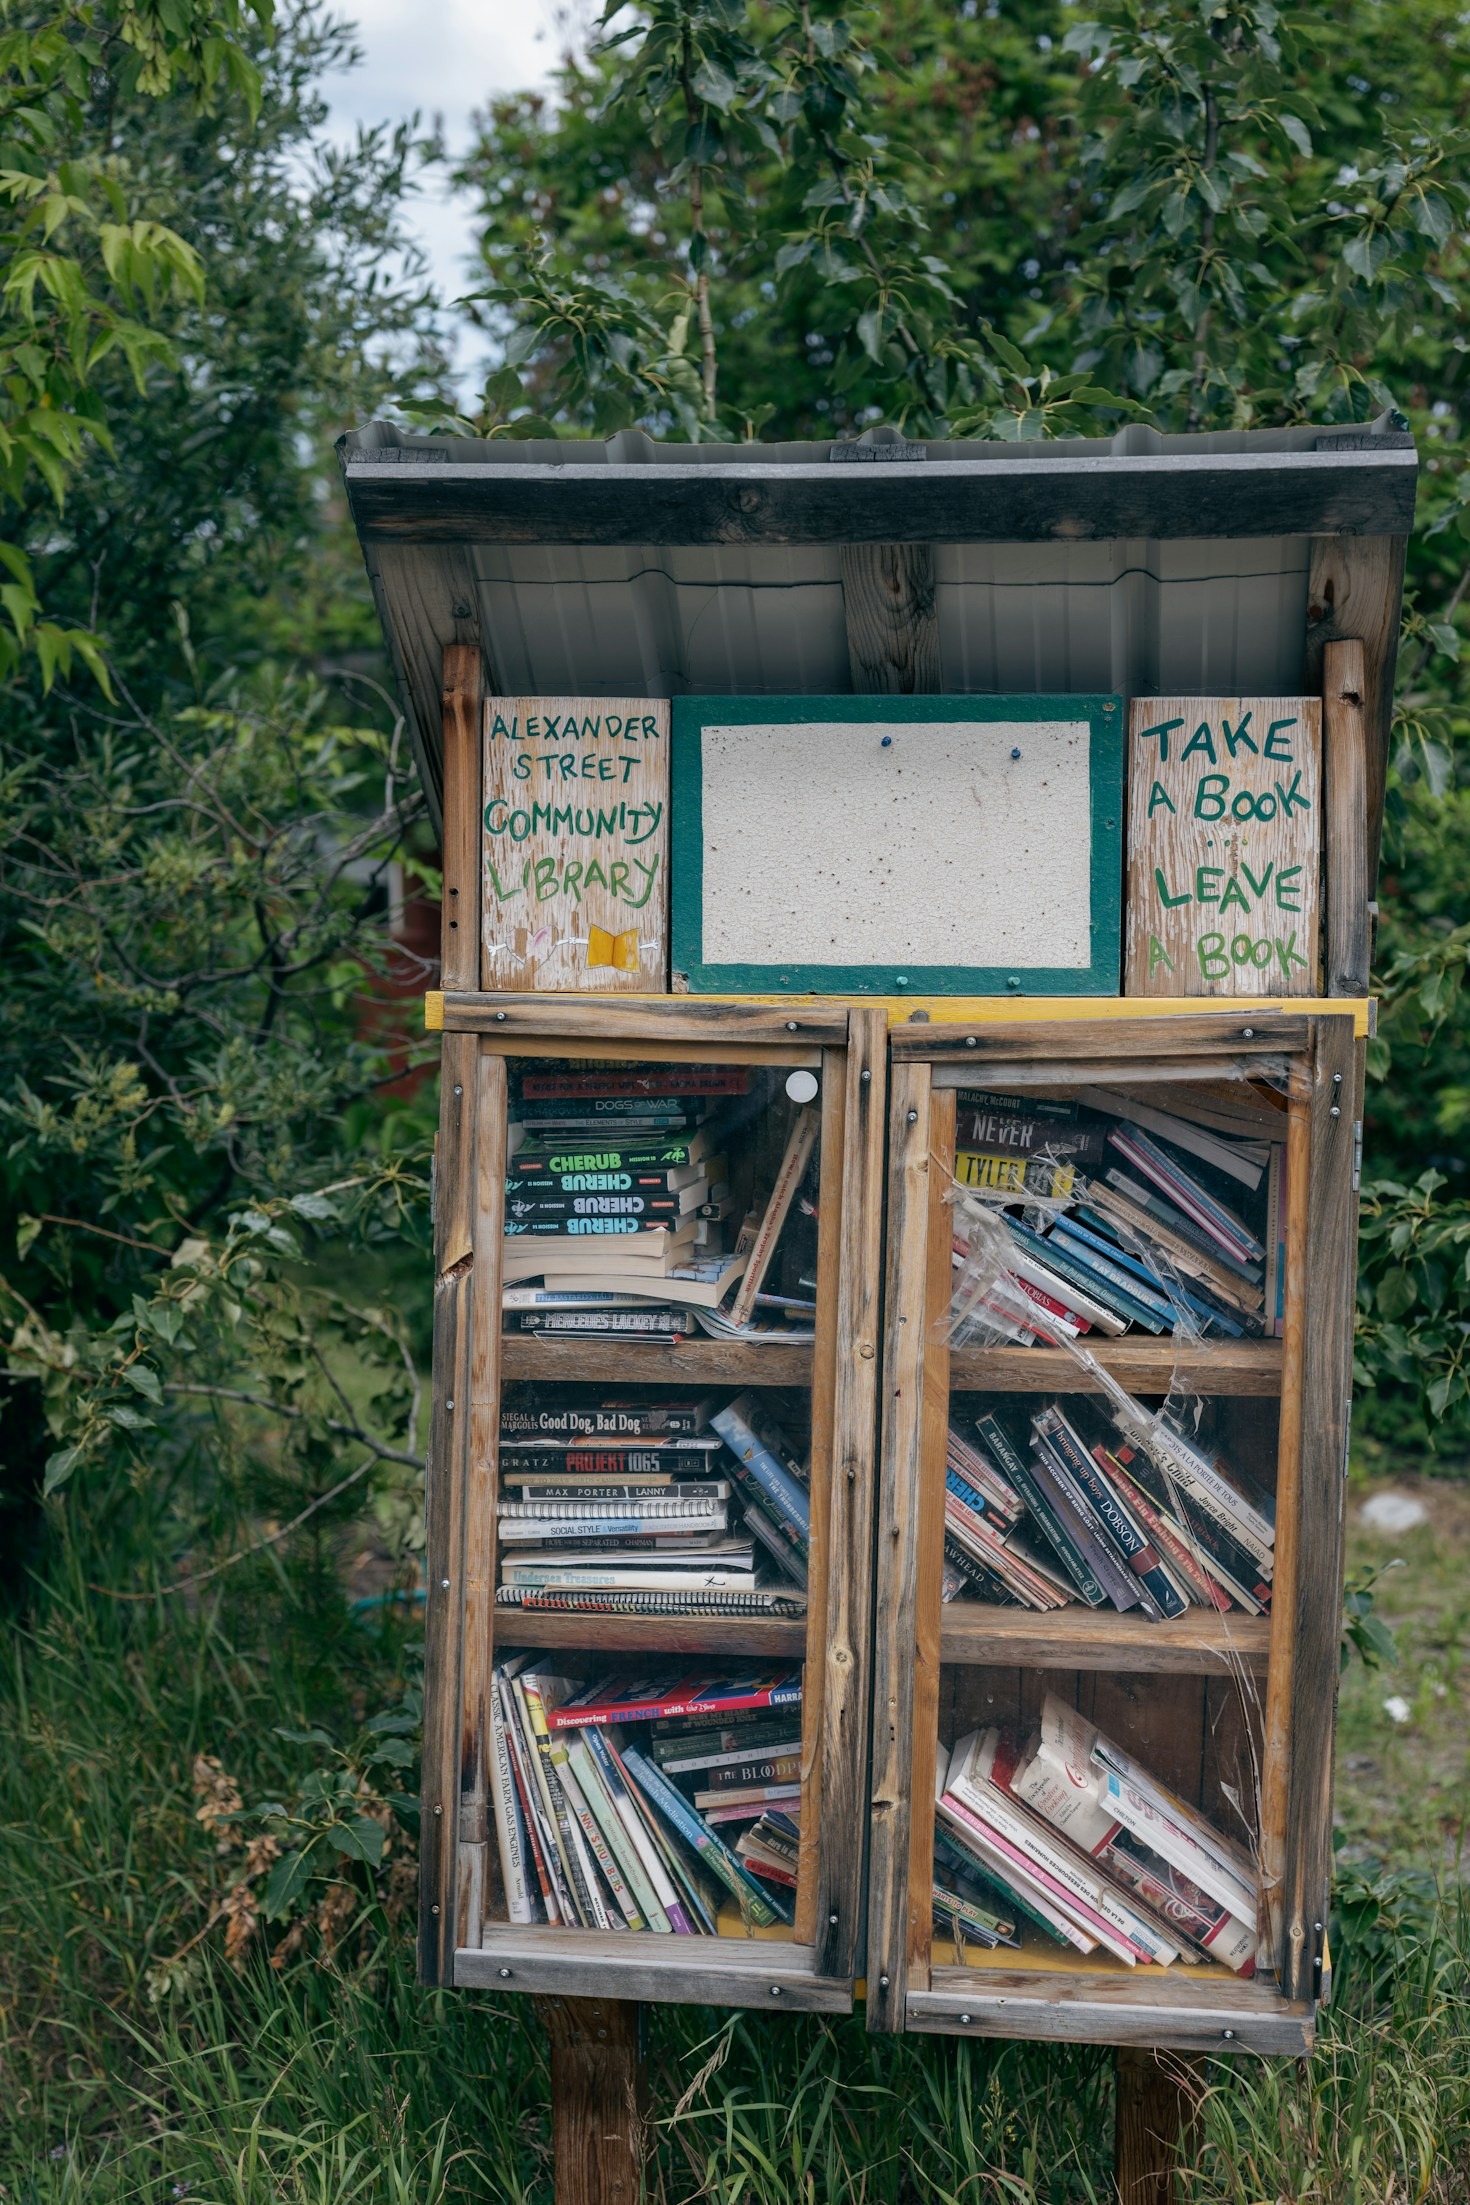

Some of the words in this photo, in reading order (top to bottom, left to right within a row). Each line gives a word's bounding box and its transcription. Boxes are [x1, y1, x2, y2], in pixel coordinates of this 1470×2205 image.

[491, 714, 659, 741] ALEXANDER
[1141, 711, 1298, 765] TAKE
[513, 753, 641, 783] STREET
[1148, 781, 1176, 818] A
[1194, 769, 1311, 822] BOOK
[484, 799, 663, 845] COMMUNITY
[487, 853, 660, 909] LIBRARY
[1155, 861, 1302, 915] LEAVE
[1150, 934, 1175, 979] A
[1198, 930, 1308, 980] BOOK
[595, 1100, 632, 1110] DOGS
[645, 1098, 677, 1109] WAR
[957, 1090, 988, 1105] MALACHY
[989, 1095, 1020, 1107] McCOURT
[972, 1114, 1034, 1148] NEVER
[548, 1152, 622, 1173] CHERUB
[787, 1152, 799, 1169] How
[560, 1172, 631, 1192] CHERUB
[784, 1171, 791, 1179] to
[963, 1156, 1018, 1190] TYLER
[777, 1179, 789, 1200] catch
[572, 1194, 644, 1215] CHERUB
[766, 1200, 783, 1231] Alaska's
[565, 1216, 638, 1234] CHERUB
[754, 1231, 771, 1258] Trophy
[741, 1258, 761, 1293] Sportfish
[1058, 1261, 1069, 1271] THE
[1086, 1279, 1103, 1293] SOCIAL
[1091, 1260, 1110, 1276] RAY
[1108, 1272, 1155, 1306] BRADBURY
[1021, 1283, 1052, 1306] TOBIAS
[544, 1313, 608, 1328] MERCEDES
[612, 1314, 656, 1330] LACKEY
[501, 1413, 528, 1421] SIEGAL
[501, 1421, 538, 1430] MARGOLIS
[539, 1412, 567, 1429] Good
[569, 1414, 594, 1434] Dog,
[596, 1414, 616, 1430] Bad
[618, 1415, 640, 1434] Dog
[502, 1458, 550, 1466] GRATZ
[566, 1452, 625, 1471] PROJEKT
[628, 1452, 660, 1471] 1065
[987, 1431, 1019, 1473] BARANGAY
[1179, 1449, 1190, 1460] À
[1184, 1456, 1196, 1467] LA
[961, 1446, 983, 1467] NORTHERN
[979, 1464, 1003, 1487] ADVENTURE
[1053, 1430, 1084, 1467] bringing
[1076, 1466, 1090, 1481] up
[1085, 1478, 1105, 1500] boys
[1164, 1459, 1196, 1490] Child
[1192, 1462, 1216, 1486] PORTÉE
[545, 1488, 568, 1496] MAX
[577, 1488, 618, 1496] PORTER
[635, 1487, 666, 1495] LANNY
[945, 1471, 987, 1513] CHER
[1037, 1452, 1049, 1466] THIS
[1046, 1464, 1067, 1491] ACCIDENT
[1064, 1490, 1073, 1500] OF
[1070, 1499, 1085, 1516] BEING
[1082, 1515, 1095, 1530] LOST
[1213, 1482, 1223, 1493] DE
[1220, 1489, 1238, 1507] TOUS
[767, 1480, 780, 1494] THE
[776, 1491, 810, 1532] THUNDERBOLT
[951, 1497, 965, 1510] HOME
[1019, 1482, 1039, 1508] OPERATIONS
[1038, 1511, 1062, 1543] ORGANIZATIONS
[1196, 1493, 1219, 1516] Joyce
[1215, 1511, 1238, 1534] Bright
[550, 1525, 576, 1535] SOCIAL
[577, 1524, 600, 1533] STYLE
[607, 1523, 638, 1533] Versatility
[1098, 1499, 1140, 1552] DOBSON
[1109, 1469, 1136, 1498] basic
[1130, 1496, 1152, 1518] Fly
[1144, 1513, 1183, 1555] Fishing
[1181, 1558, 1195, 1574] Fly
[582, 1539, 620, 1547] SEPARATED
[624, 1538, 653, 1546] CHAPMAN
[1087, 1543, 1106, 1566] Fresh
[1242, 1537, 1266, 1560] NAIAD
[513, 1570, 561, 1583] Undersea
[563, 1572, 615, 1585] Treasures
[1125, 1578, 1141, 1597] SIMPSON
[488, 1683, 501, 1721] CLASSIC
[555, 1712, 607, 1728] Discovering
[610, 1707, 660, 1722] FRENCH
[663, 1704, 685, 1715] with
[682, 1720, 692, 1728] AT
[694, 1716, 735, 1727] WOUNDED
[736, 1714, 758, 1723] KNEE
[493, 1723, 508, 1775] AMERICAN
[589, 1733, 603, 1751] Open
[597, 1749, 611, 1768] Water
[634, 1760, 655, 1781] Living
[659, 1786, 673, 1801] Life
[718, 1770, 737, 1780] THE
[501, 1777, 512, 1804] FARM
[1045, 1789, 1068, 1815] Cooking
[504, 1805, 515, 1826] GAS
[635, 1771, 660, 1798] Jewish
[657, 1796, 696, 1838] Meditation
[1112, 1806, 1136, 1827] CHILTON
[951, 1801, 965, 1813] Tom
[963, 1812, 993, 1837] Slaughter
[507, 1827, 521, 1868] ENGINES
[575, 1804, 602, 1844] ANNE'S
[592, 1842, 625, 1893] NUMBERS
[766, 1836, 782, 1850] dare
[1023, 1838, 1050, 1862] HUMAINES
[1047, 1859, 1081, 1887] RESSOURCES
[514, 1877, 524, 1898] Arnold
[1079, 1885, 1091, 1896] DES
[931, 1888, 952, 1904] WANTS
[950, 1899, 961, 1909] TO
[960, 1905, 977, 1918] PLAY
[1110, 1911, 1117, 1919] LA
[1116, 1917, 1124, 1925] DE
